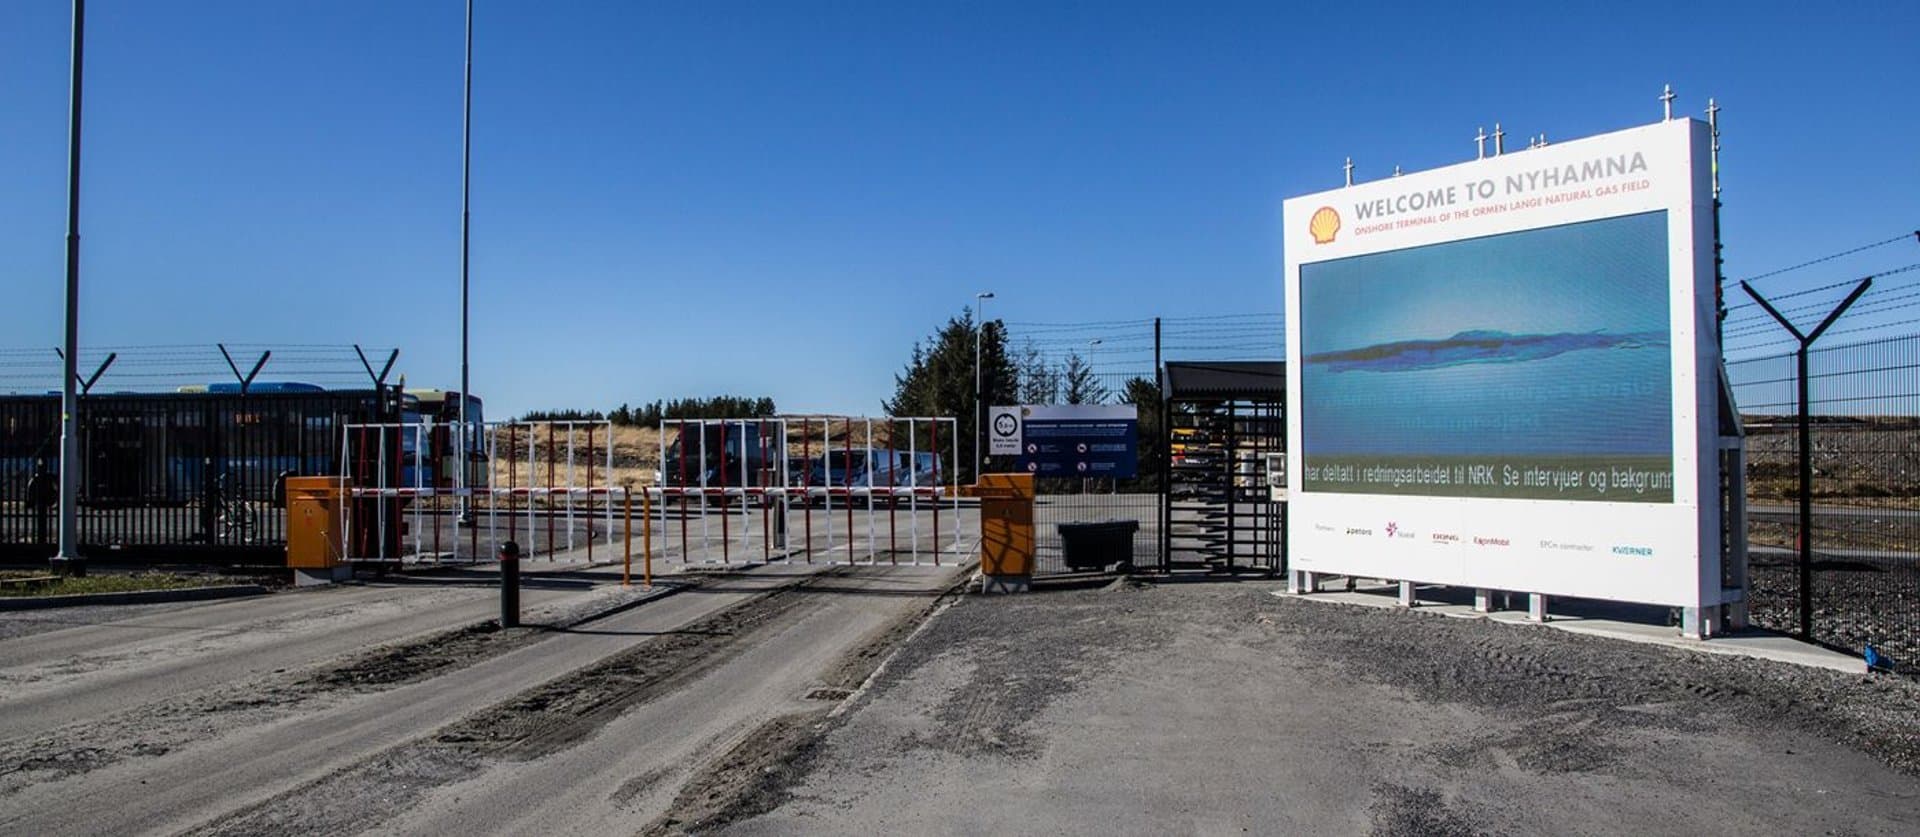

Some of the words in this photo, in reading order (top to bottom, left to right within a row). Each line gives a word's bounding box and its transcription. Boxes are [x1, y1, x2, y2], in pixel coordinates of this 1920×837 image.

[1354, 186, 1457, 221] WELCOME
[1465, 178, 1496, 201] TO
[1505, 151, 1648, 195] NYHAMNA
[1354, 223, 1394, 235] ONSHORE
[1396, 216, 1437, 229] TERMINAL
[1439, 213, 1452, 223] OF
[1454, 210, 1470, 219] THE
[1472, 203, 1507, 217] ORMEN
[1509, 197, 1543, 211] LANGE
[1545, 190, 1593, 205] NATURAL
[1595, 184, 1619, 197] GAS
[1621, 179, 1650, 192] FIELD
[1322, 464, 1354, 483] deltatt
[1356, 466, 1361, 482] i
[1362, 464, 1450, 488] redningsarbeidet
[1453, 465, 1465, 485] til
[1502, 464, 1520, 487] Se
[1523, 465, 1585, 492] intervjuer
[1588, 470, 1607, 493] og
